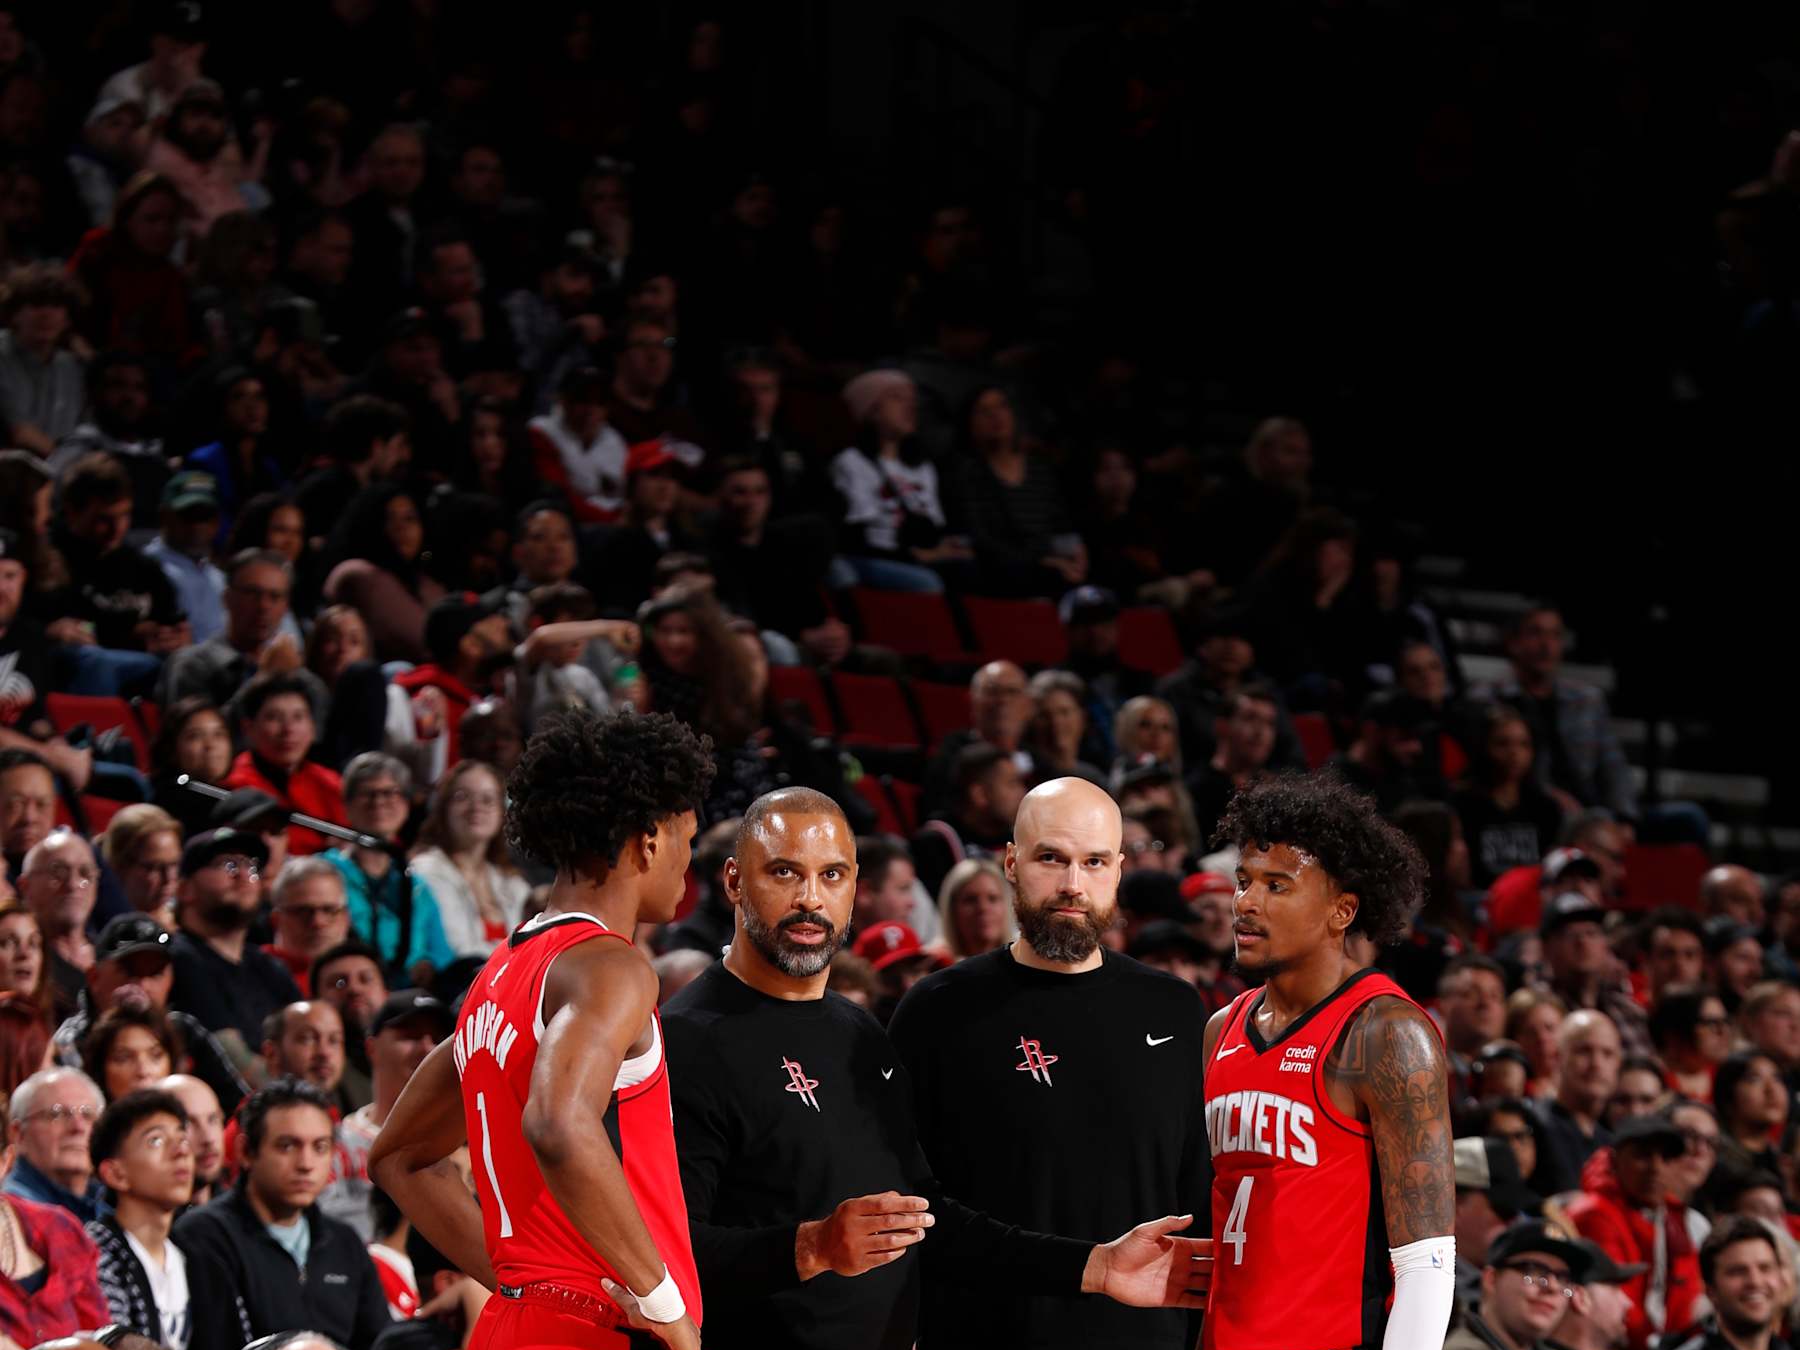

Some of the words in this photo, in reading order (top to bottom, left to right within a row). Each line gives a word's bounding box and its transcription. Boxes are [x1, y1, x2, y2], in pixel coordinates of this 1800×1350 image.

[1278, 1057, 1312, 1074] karma
[1285, 1044, 1317, 1060] credit
[476, 1091, 513, 1239] 1
[1222, 1175, 1255, 1266] 4
